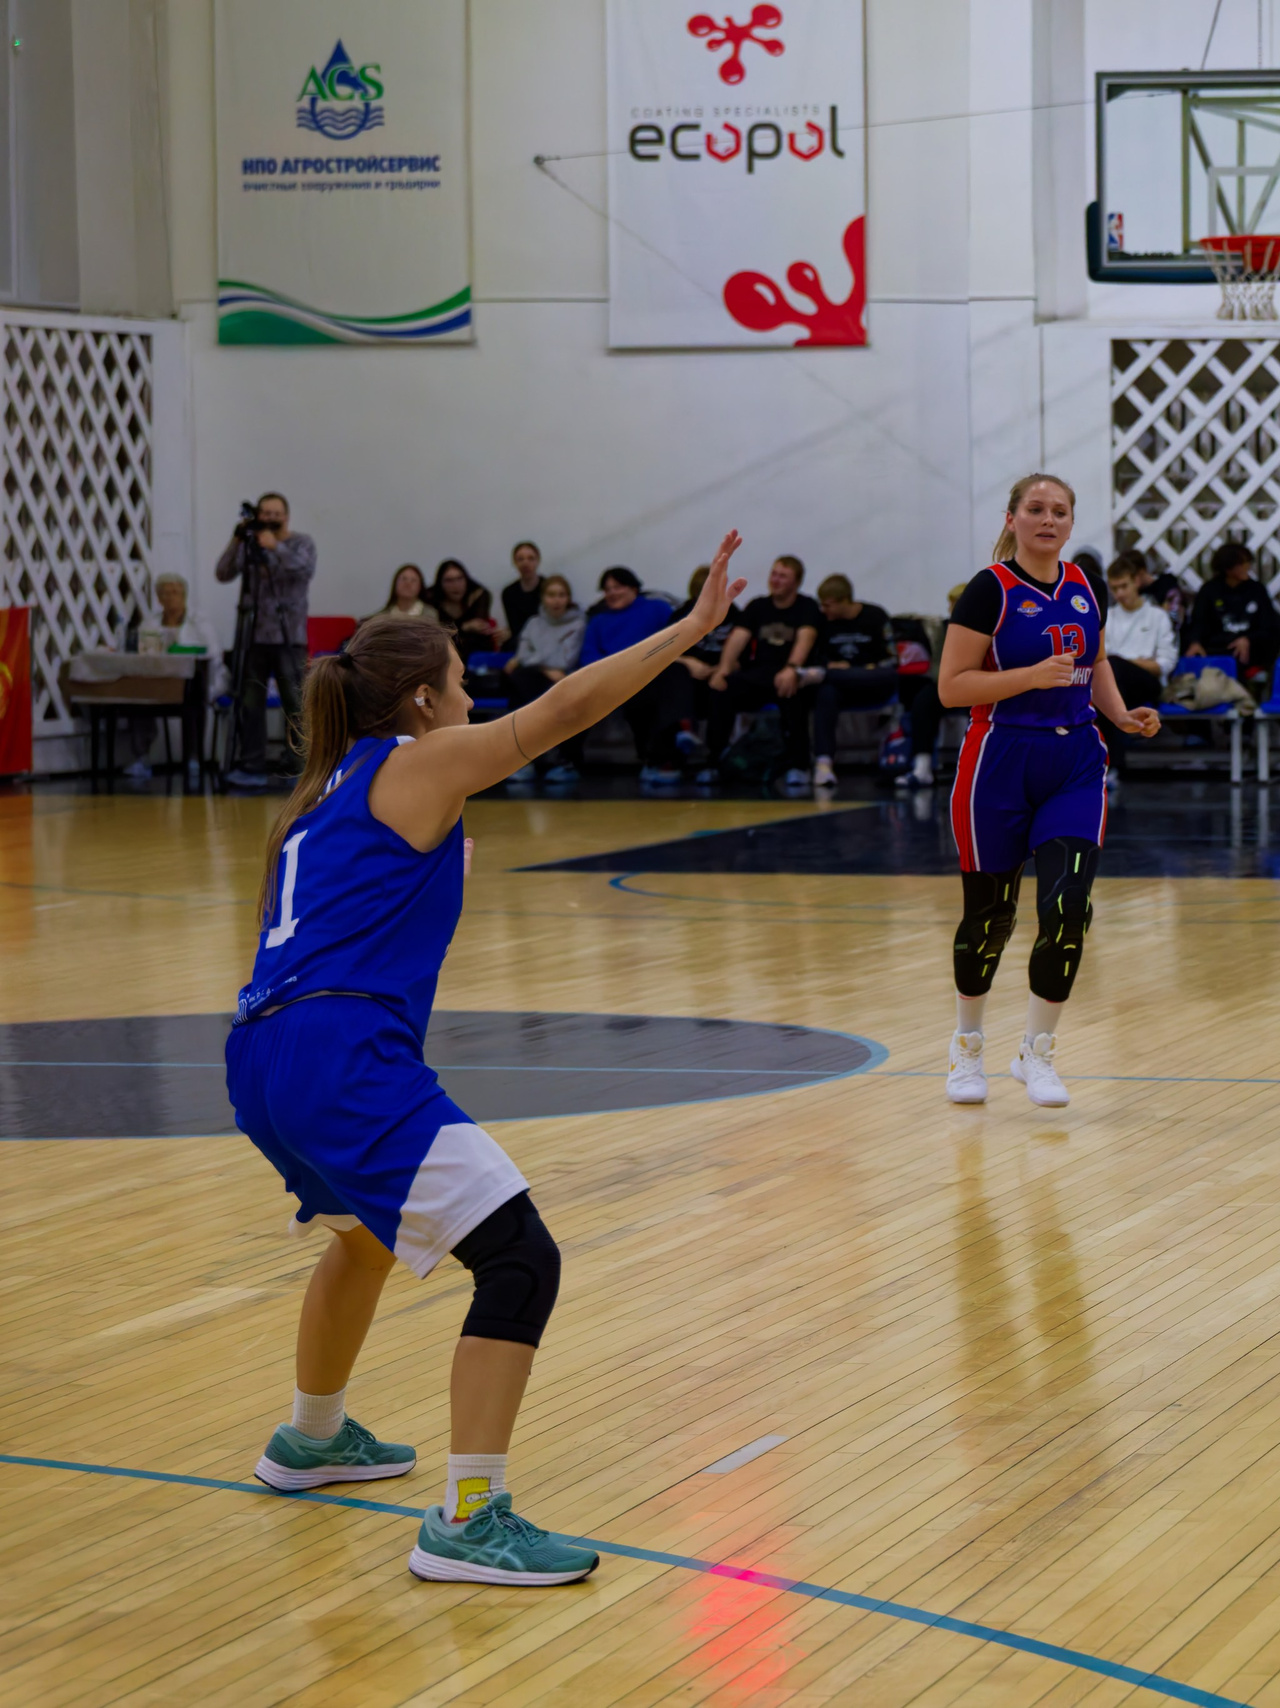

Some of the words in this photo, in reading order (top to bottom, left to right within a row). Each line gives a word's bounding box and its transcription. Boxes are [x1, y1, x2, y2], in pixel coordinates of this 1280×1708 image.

[296, 63, 384, 101] ACS
[630, 106, 704, 118] COATING
[713, 104, 821, 117] SPECIALISTS
[628, 104, 845, 175] ecopol
[280, 154, 441, 175] АГРОСТРОЙСЕРВИС
[1041, 623, 1087, 659] 13
[265, 829, 309, 949] 1
